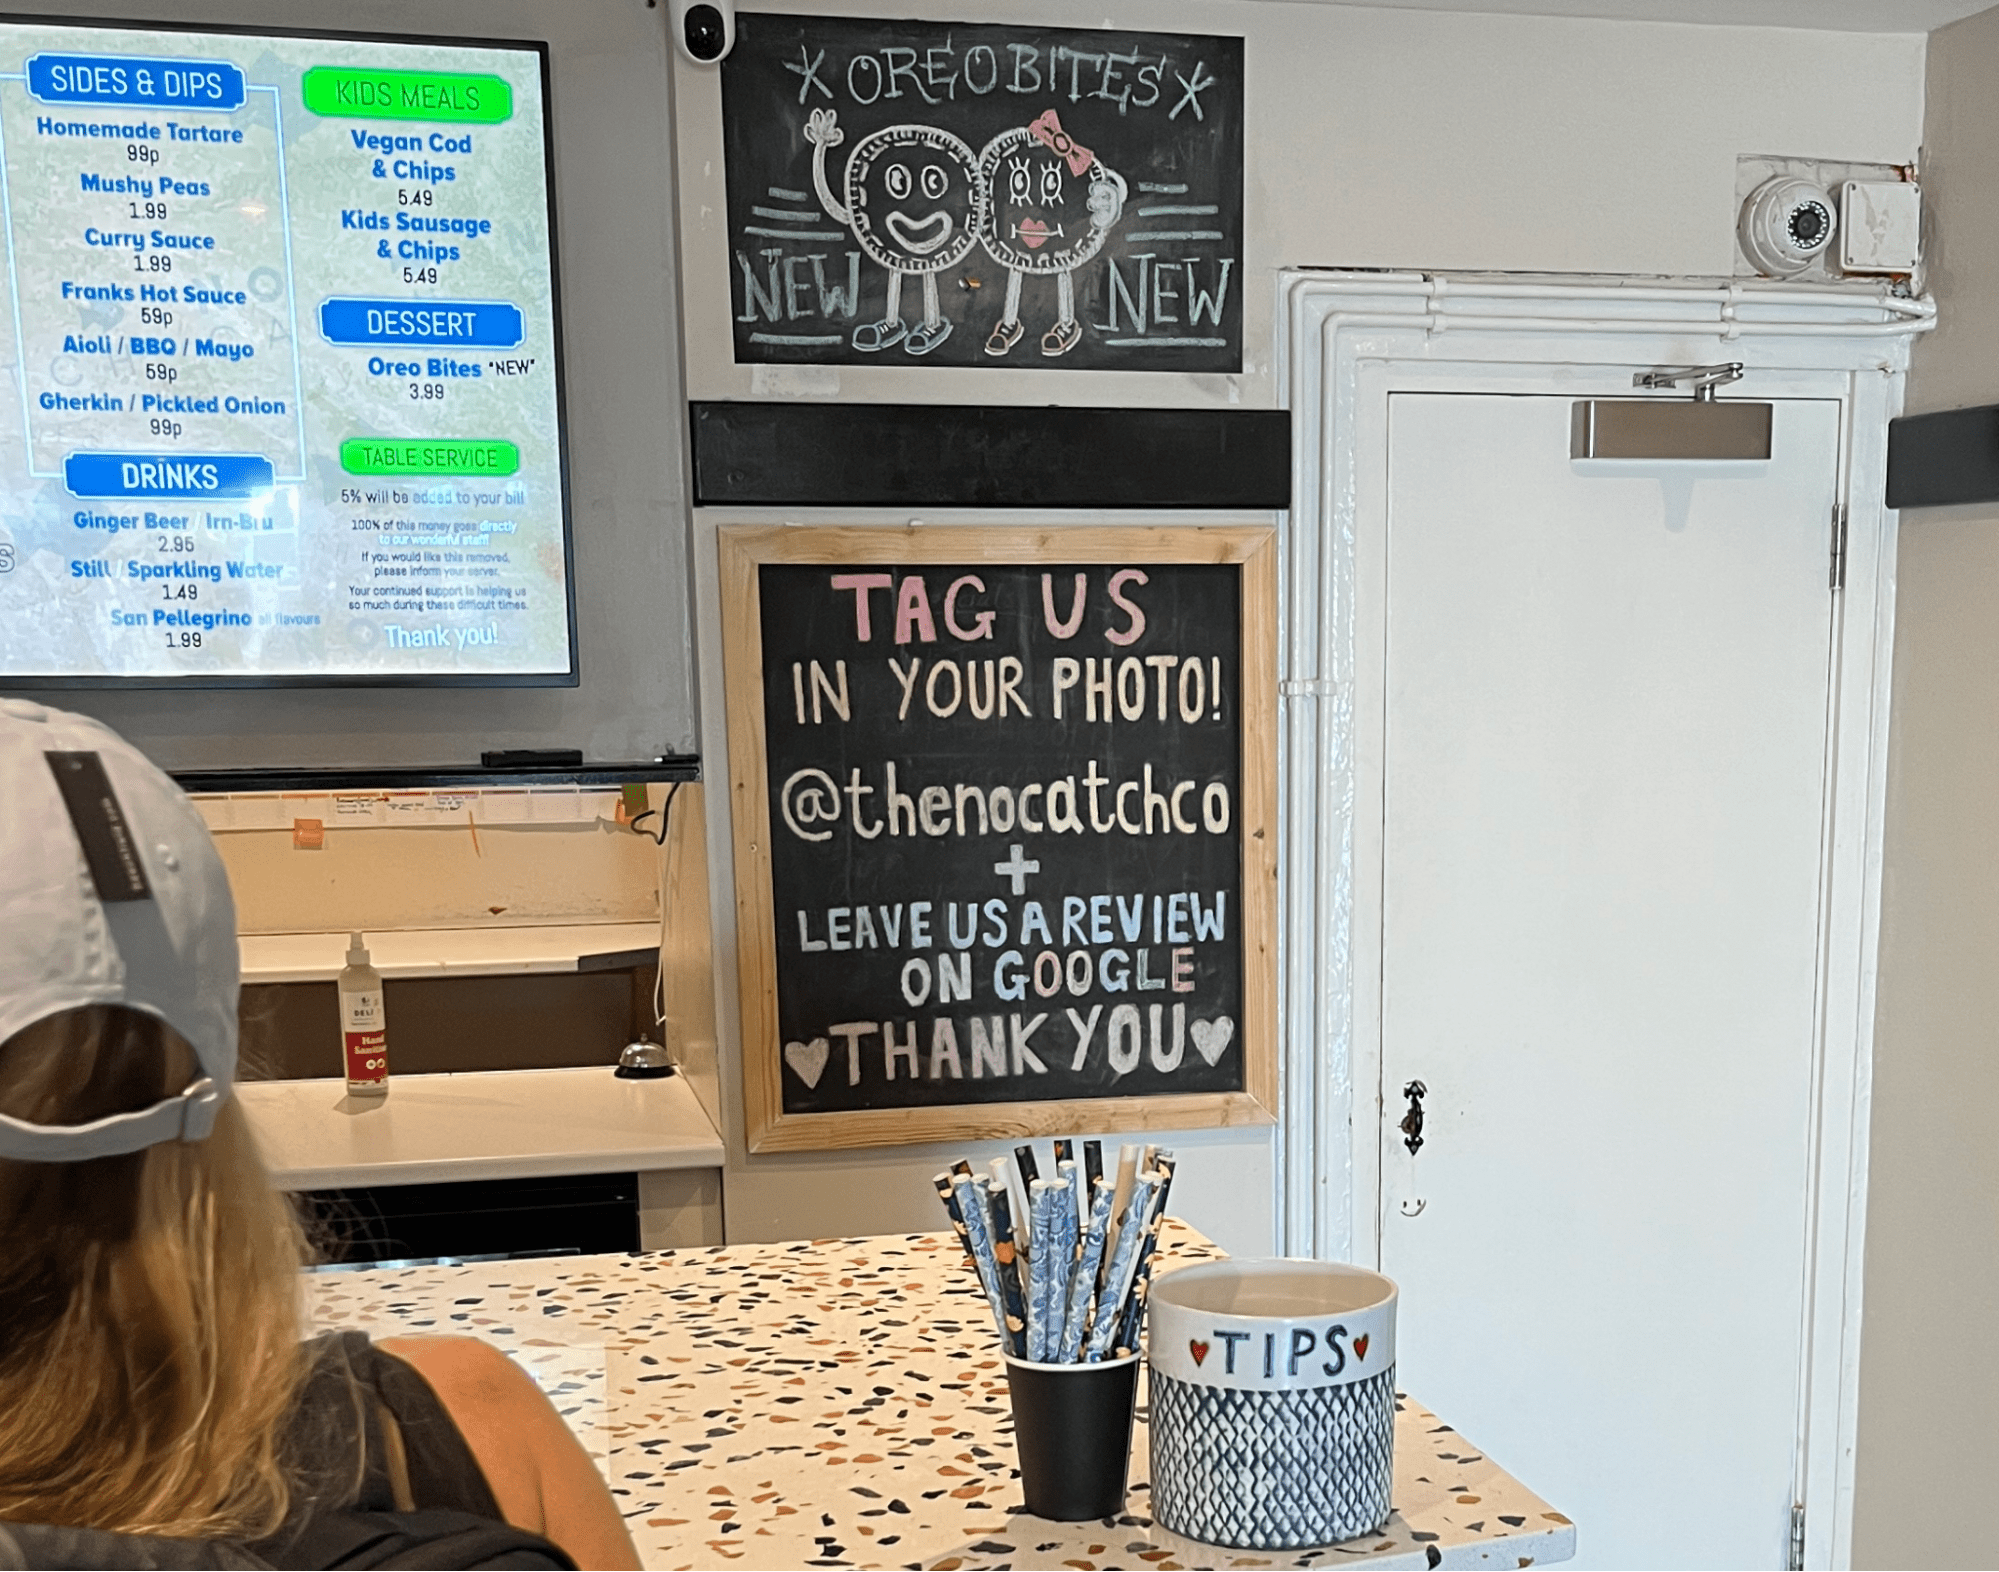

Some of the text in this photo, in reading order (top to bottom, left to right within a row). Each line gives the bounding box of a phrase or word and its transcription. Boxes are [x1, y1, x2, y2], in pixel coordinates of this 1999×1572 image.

[51, 65, 222, 99] SIDES & DIPS
[336, 79, 480, 110] KIDS MEALS
[37, 116, 243, 143] Homemade Tartare
[351, 129, 472, 155] Vegan Cod
[127, 144, 159, 166] 99p
[372, 159, 456, 184] & Chips
[80, 173, 211, 197] Mushy Peas
[398, 189, 433, 206] 5.49
[129, 202, 167, 219] 1.99
[341, 210, 491, 238] Kids Sausage
[85, 227, 215, 252] Curry Sauce
[377, 239, 460, 264] & Chips
[134, 255, 171, 272] 1.99
[403, 267, 437, 284] 5.49
[735, 248, 861, 322] NEW
[61, 281, 246, 304] Franks Hot Sauce
[1092, 252, 1235, 335] NEW
[141, 307, 173, 328] 59p
[367, 309, 477, 337] DESSERT
[63, 335, 255, 361] Aioli / BBQ / Mayo
[146, 363, 178, 384] 59p
[368, 356, 421, 376] Oreo
[427, 358, 482, 378] Bites
[39, 391, 286, 415] Gherkin / Pickled Onion
[409, 383, 444, 400] 3.99
[150, 418, 182, 439] 99p
[363, 447, 498, 468] TABLE SERVICE
[123, 462, 219, 490] DRINKS
[341, 488, 362, 504] 5%
[365, 489, 389, 504] will
[392, 489, 409, 504] be
[456, 491, 471, 504] to
[473, 492, 502, 507] your
[73, 510, 139, 533] Ginger
[144, 512, 189, 530] Beer
[351, 518, 381, 531] 100%
[418, 521, 451, 534] money
[158, 535, 195, 553] 2.95
[371, 553, 389, 564] you
[391, 551, 421, 562] would
[70, 559, 112, 578] Still
[128, 560, 221, 582] Sparkling
[225, 561, 283, 579] Water
[162, 583, 198, 600] 1.49
[349, 585, 371, 596] Your
[373, 585, 423, 597] continued
[363, 600, 391, 610] much
[393, 600, 424, 613] during
[830, 574, 996, 645] TAG
[111, 609, 148, 627] San
[153, 608, 252, 630] Pellegrino
[165, 632, 202, 648] 1.99
[384, 621, 499, 651] Thank you!
[792, 654, 1222, 725] IN YOUR PHOTO!
[780, 759, 1231, 842] @thenocatchco
[797, 890, 1227, 953] LEAVE US A REVIEW
[900, 945, 1197, 1008] ON GOOGLE
[828, 1001, 1187, 1087] THANK YOU
[1213, 1323, 1349, 1379] TIPS
